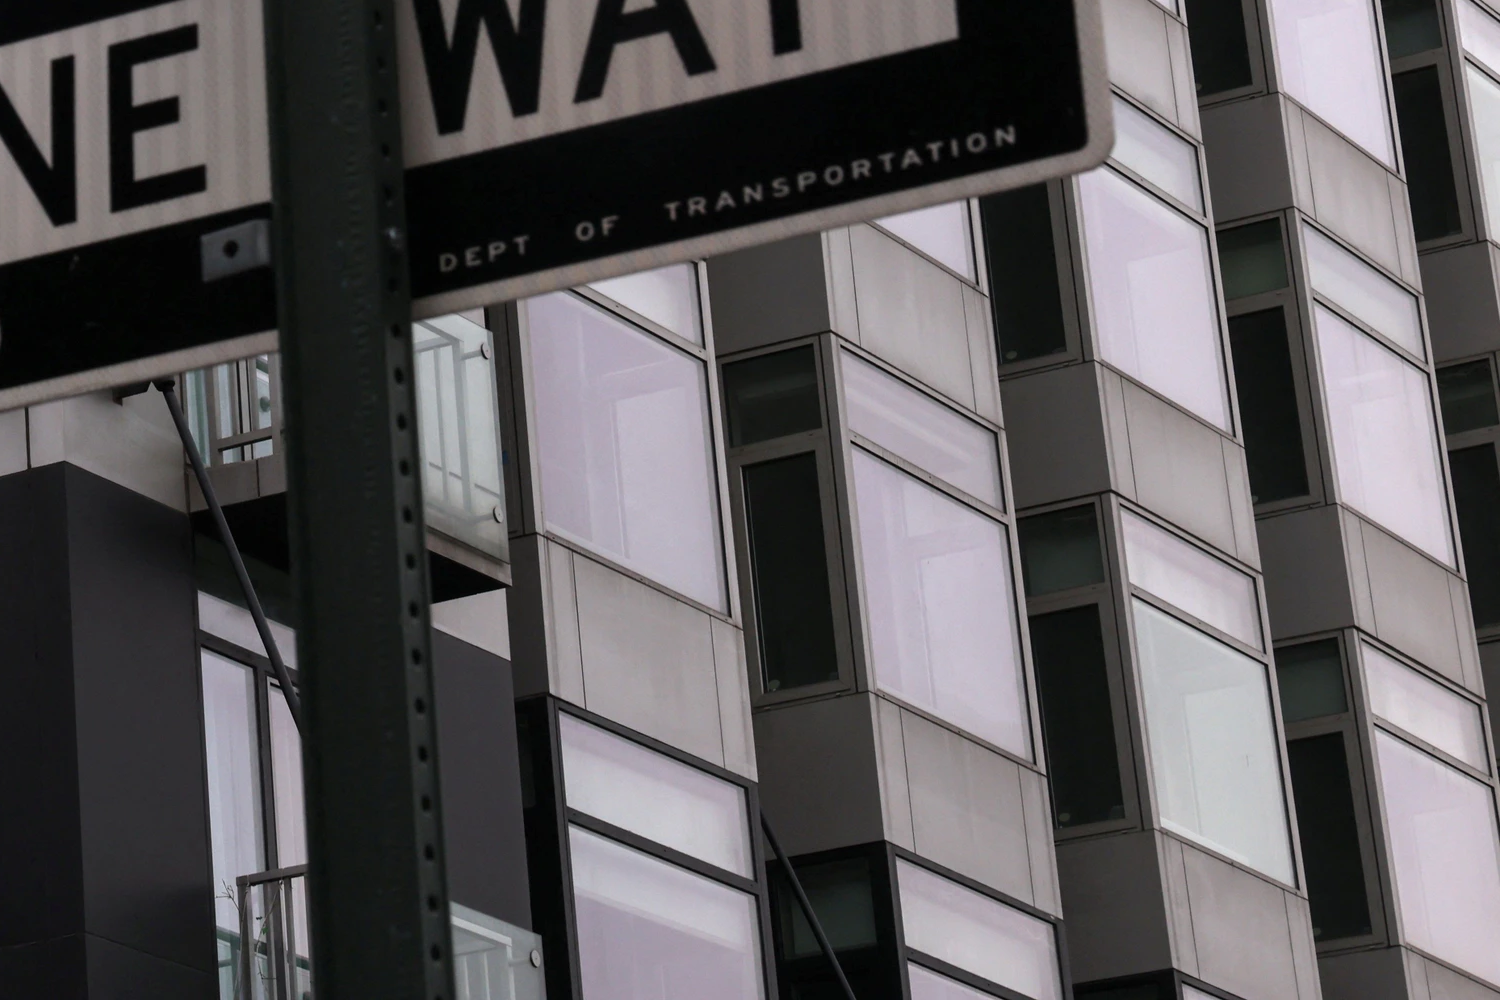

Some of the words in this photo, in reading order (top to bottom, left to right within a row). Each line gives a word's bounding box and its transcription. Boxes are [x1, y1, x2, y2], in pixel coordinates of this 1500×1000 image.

[438, 234, 533, 273] DEPT
[574, 215, 620, 243] OF
[663, 125, 1018, 222] TRANSPORTATION
